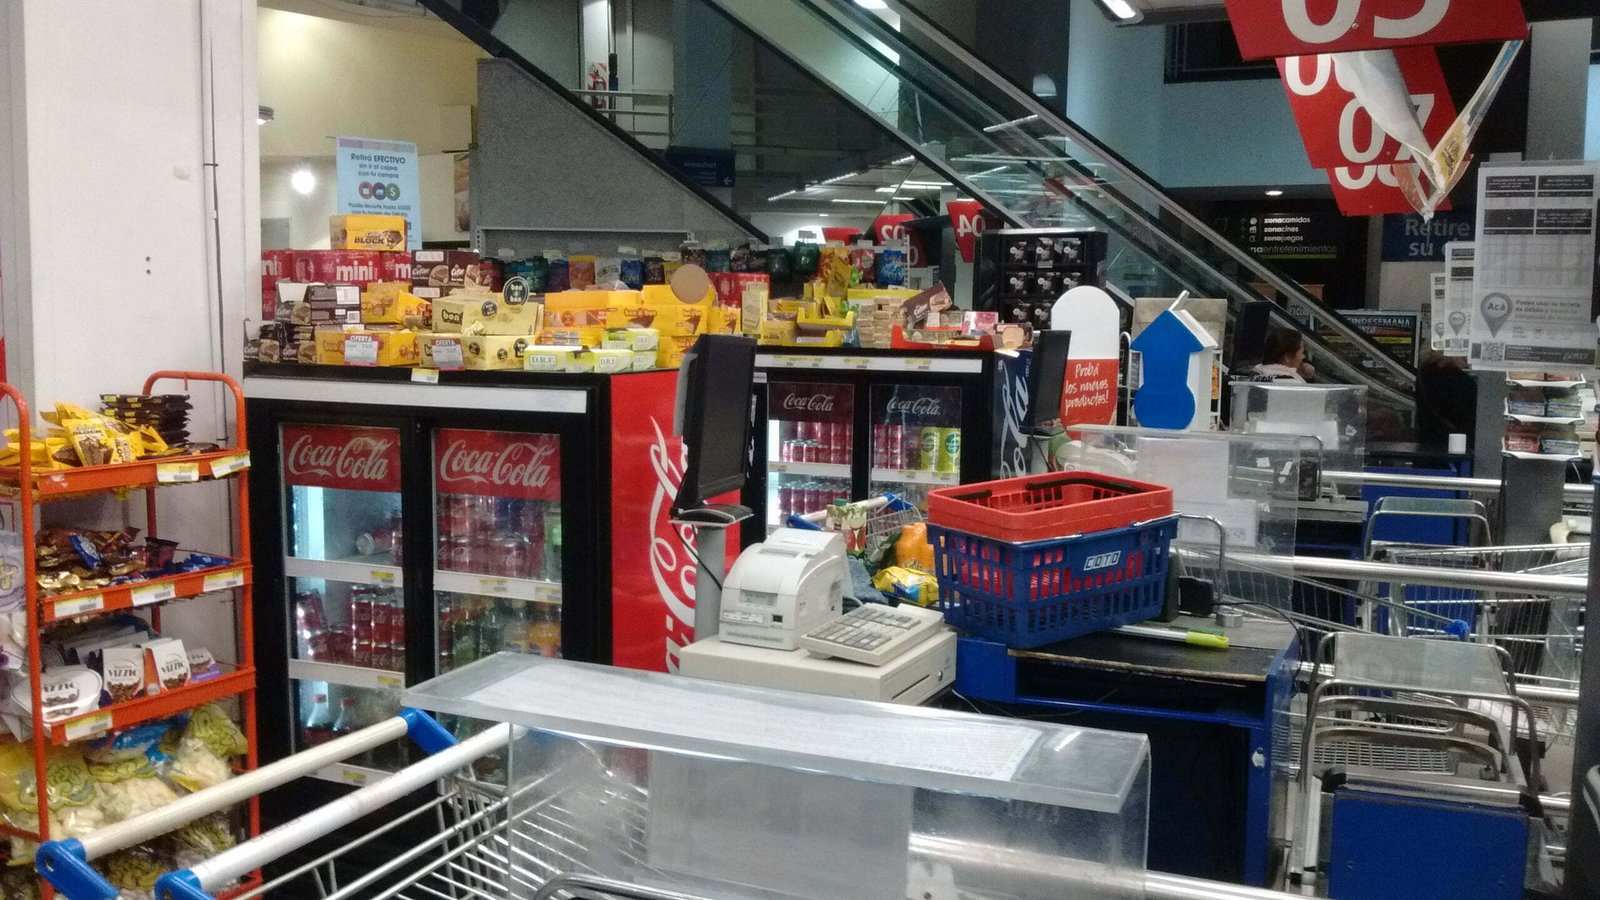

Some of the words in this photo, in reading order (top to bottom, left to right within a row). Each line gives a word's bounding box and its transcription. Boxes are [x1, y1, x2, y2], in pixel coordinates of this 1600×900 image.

[374, 155, 406, 164] EFECTIVO
[1405, 219, 1470, 236] Retire
[1409, 242, 1433, 256] su
[336, 261, 373, 281] mini
[1487, 301, 1506, 311] Acá
[442, 310, 461, 321] bon
[1075, 363, 1099, 378] Probá
[1065, 380, 1077, 394] los
[1080, 379, 1108, 391] nuevos
[783, 393, 836, 412] Coca-Cola
[887, 396, 942, 415] Coca-Cola
[1065, 390, 1109, 416] productos!
[288, 434, 394, 480] Coca-Cola
[440, 440, 555, 488] Coca-Cola
[1084, 551, 1121, 571] COTO
